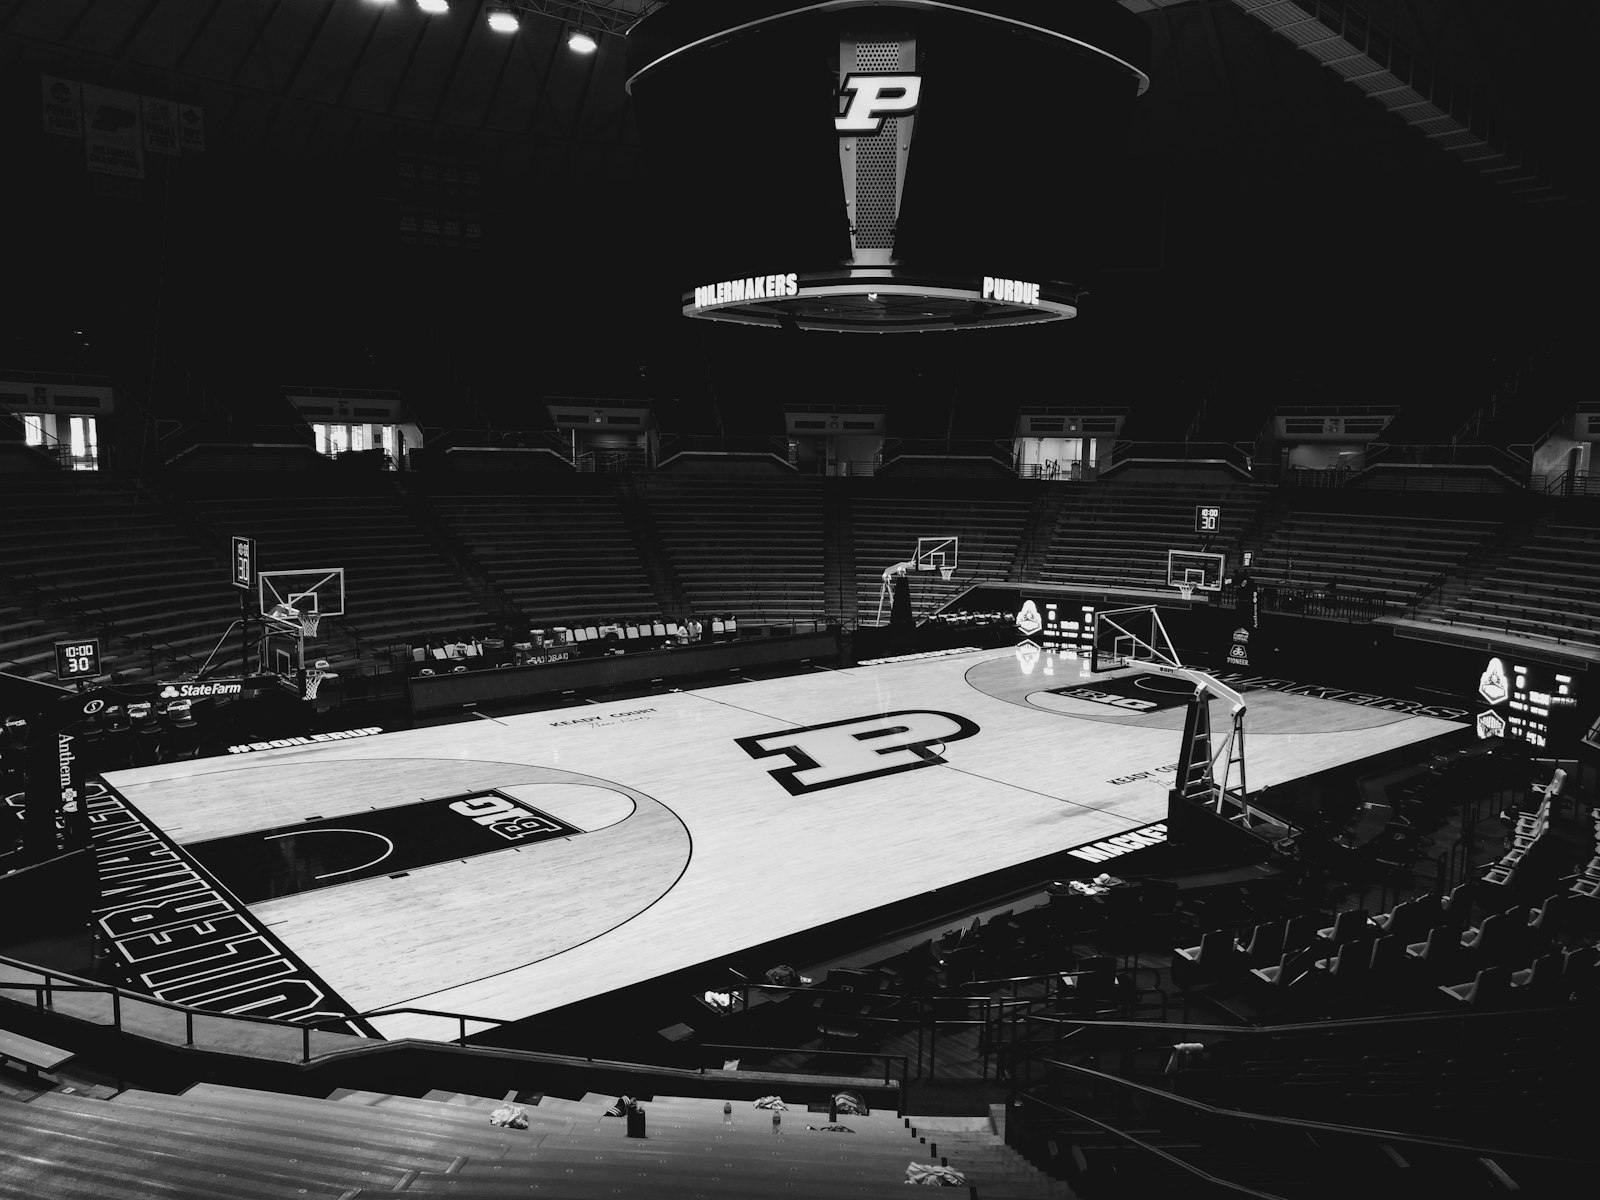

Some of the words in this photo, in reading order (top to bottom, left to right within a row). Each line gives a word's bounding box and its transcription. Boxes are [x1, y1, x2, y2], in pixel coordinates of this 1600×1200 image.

[834, 73, 923, 133] P
[695, 272, 798, 309] BOILERMAKERS
[983, 275, 1041, 306] PURDUE
[1202, 508, 1219, 518] 10:00
[1202, 517, 1216, 530] 30
[65, 644, 94, 658] 10:00
[1226, 656, 1250, 667] PIONEER
[68, 656, 90, 673] 30
[548, 716, 603, 727] KEADY
[227, 726, 384, 755] #BOILERUP
[58, 733, 76, 789] Anthem
[733, 709, 980, 797] P
